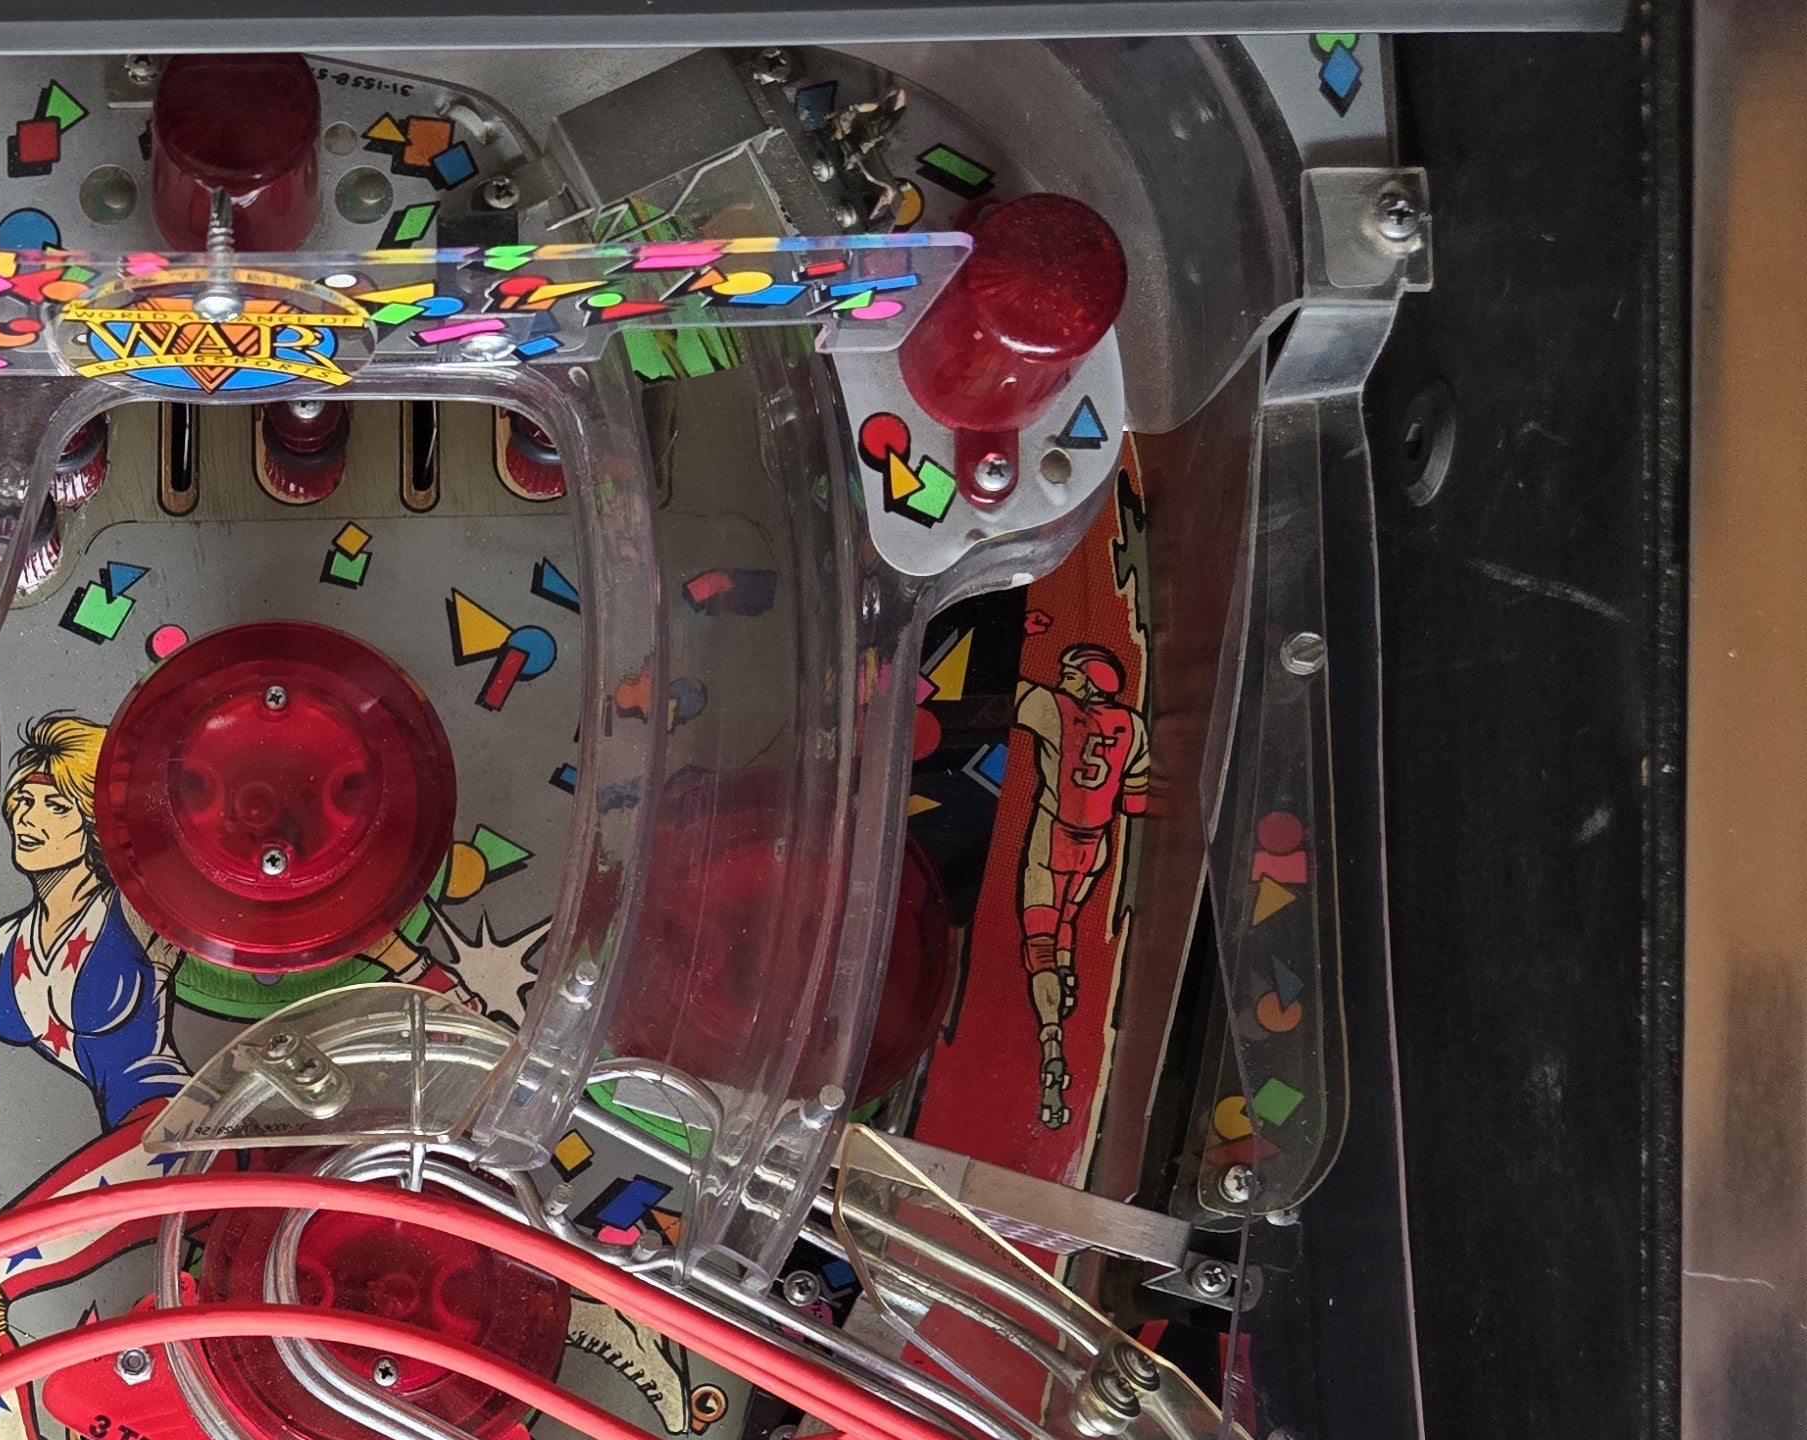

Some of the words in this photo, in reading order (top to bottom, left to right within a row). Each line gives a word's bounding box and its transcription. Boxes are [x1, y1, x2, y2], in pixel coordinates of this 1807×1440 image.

[73, 310, 169, 321] WORLD
[181, 313, 307, 324] AANCE
[320, 316, 350, 325] OF
[86, 320, 353, 379] WAR
[95, 356, 332, 379] ROLLERSPORTS
[1071, 733, 1118, 794] 5
[87, 1413, 112, 1439] 3
